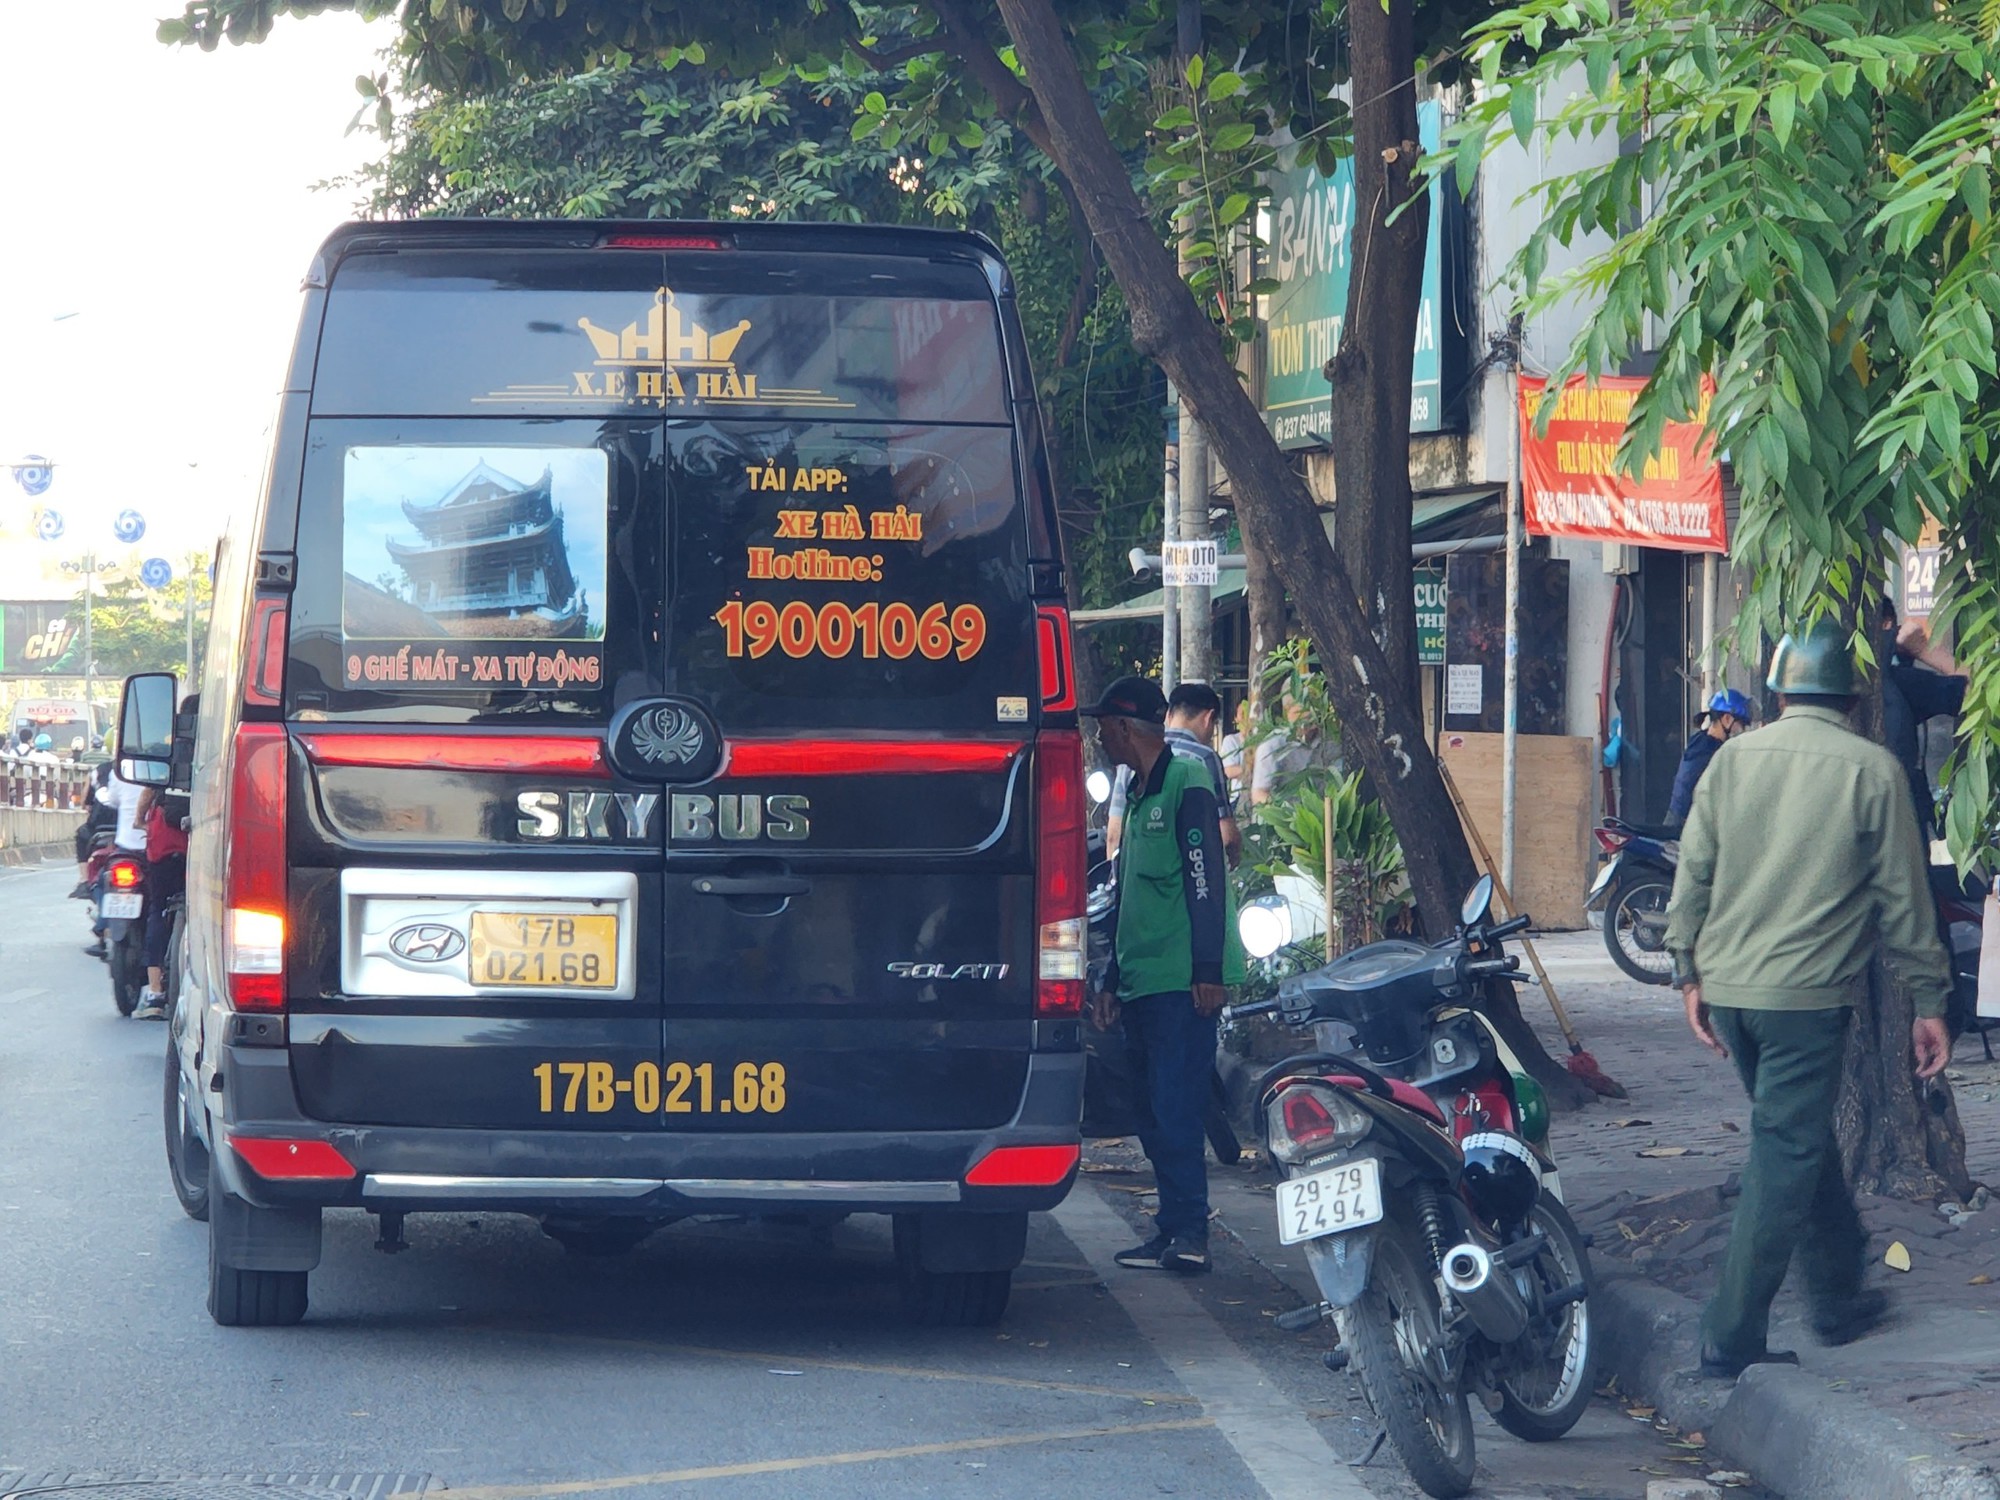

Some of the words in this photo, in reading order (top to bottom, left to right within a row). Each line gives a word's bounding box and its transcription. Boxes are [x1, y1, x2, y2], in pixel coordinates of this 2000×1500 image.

[1277, 167, 1350, 282] BÁNH
[1271, 310, 1303, 376] TÔM
[637, 366, 686, 398] HÀ
[696, 368, 758, 399] HẢI
[746, 458, 786, 491] TẢI
[792, 467, 849, 492] APP:
[1557, 441, 1578, 474] FULL
[774, 510, 817, 539] XE
[822, 504, 866, 540] HÀ
[870, 505, 922, 541] HẢI
[747, 547, 884, 581] Hotline:
[716, 601, 986, 662] 19001069
[348, 655, 361, 681] 9
[364, 645, 411, 681] GHẾ
[412, 648, 459, 681] MÁT
[472, 656, 502, 681] XA
[505, 651, 536, 687] TỰ
[536, 649, 599, 688] ĐỘNG
[1188, 848, 1209, 900] gojek
[518, 918, 575, 947] 17B
[487, 950, 599, 982] 021.68
[887, 961, 1010, 980] SOLATI
[533, 1061, 786, 1114] 17B-021.68
[1293, 1167, 1363, 1208] 29-Z9
[1295, 1193, 1366, 1235] 2494
